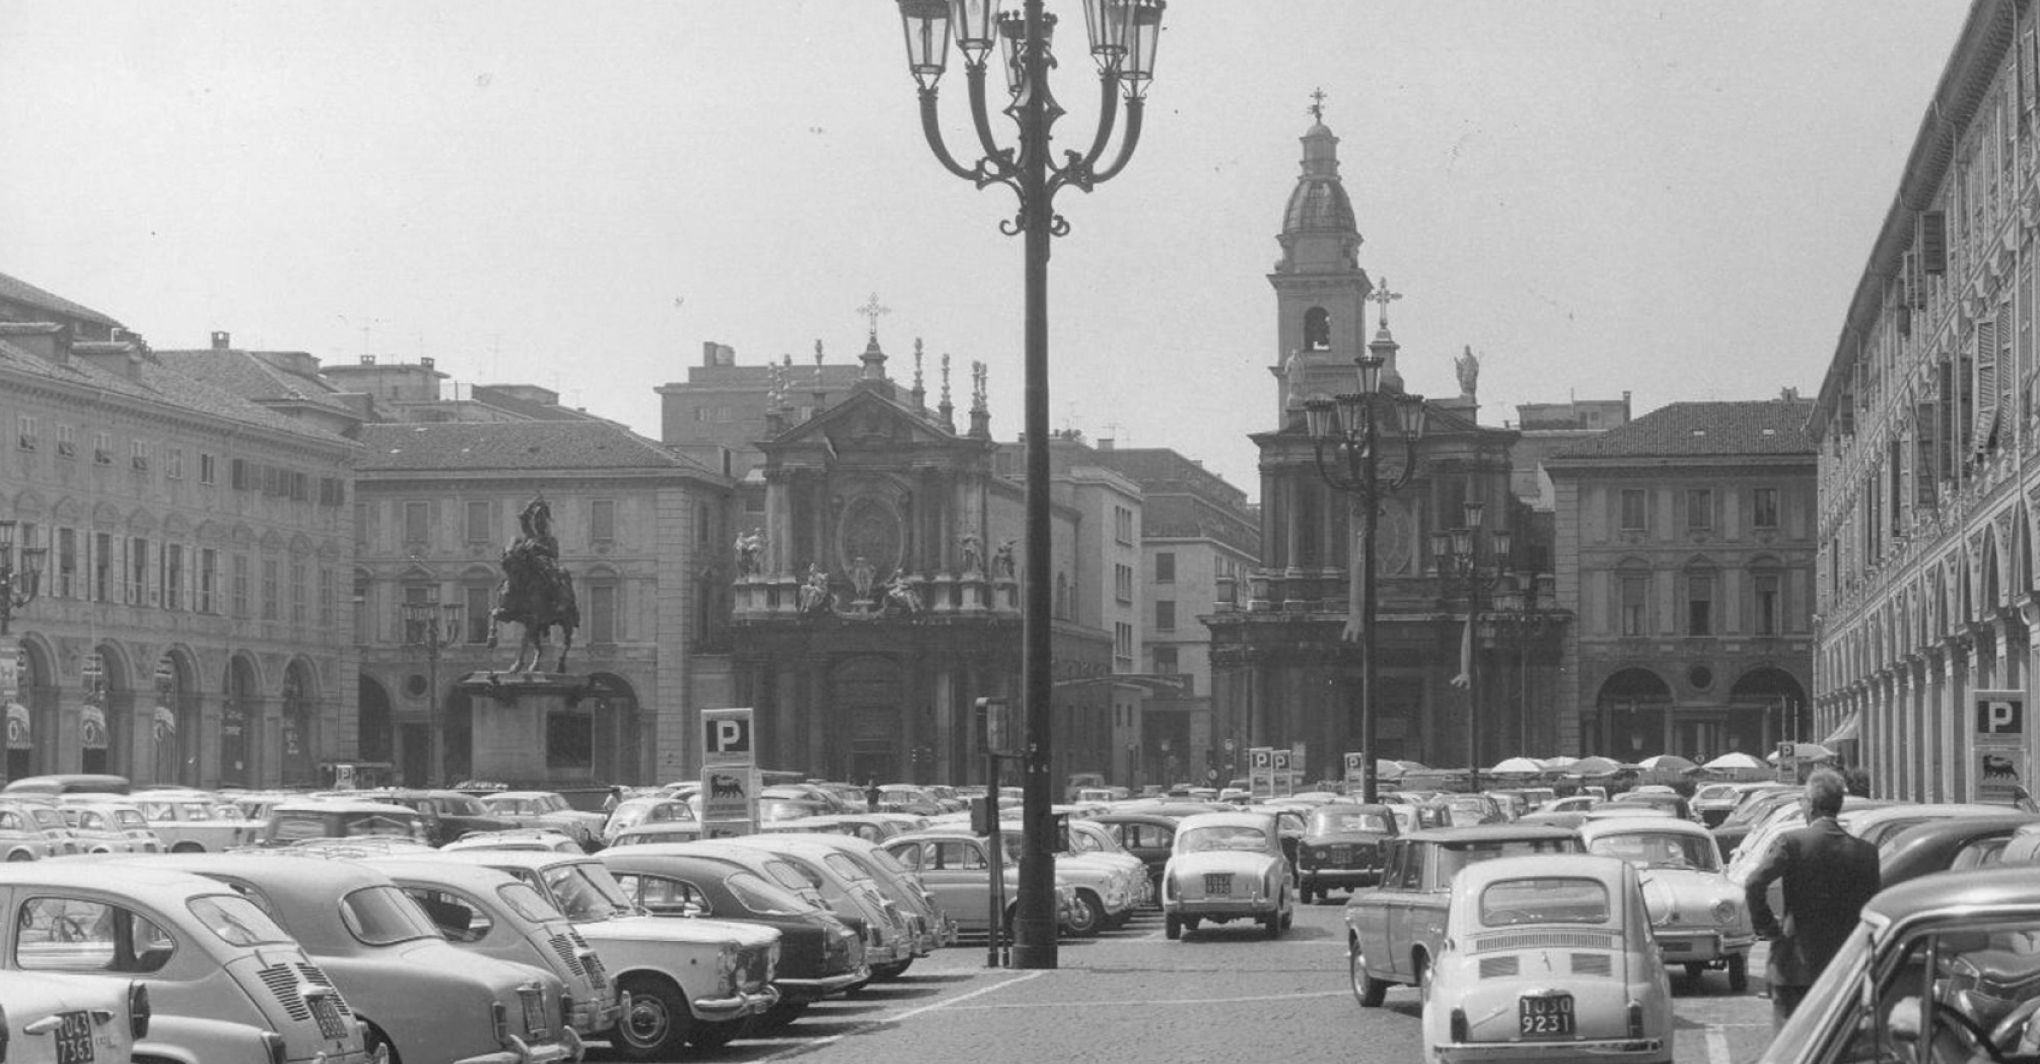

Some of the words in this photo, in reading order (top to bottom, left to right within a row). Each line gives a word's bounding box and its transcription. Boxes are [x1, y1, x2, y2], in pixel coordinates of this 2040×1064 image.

[1988, 702, 2013, 732] P
[718, 719, 740, 752] P
[1782, 746, 1791, 758] P
[1256, 753, 1267, 767] P
[1275, 756, 1285, 769] P
[1349, 756, 1358, 768] P
[1522, 1015, 1568, 1032] 9231
[59, 1038, 91, 1062] 7363
